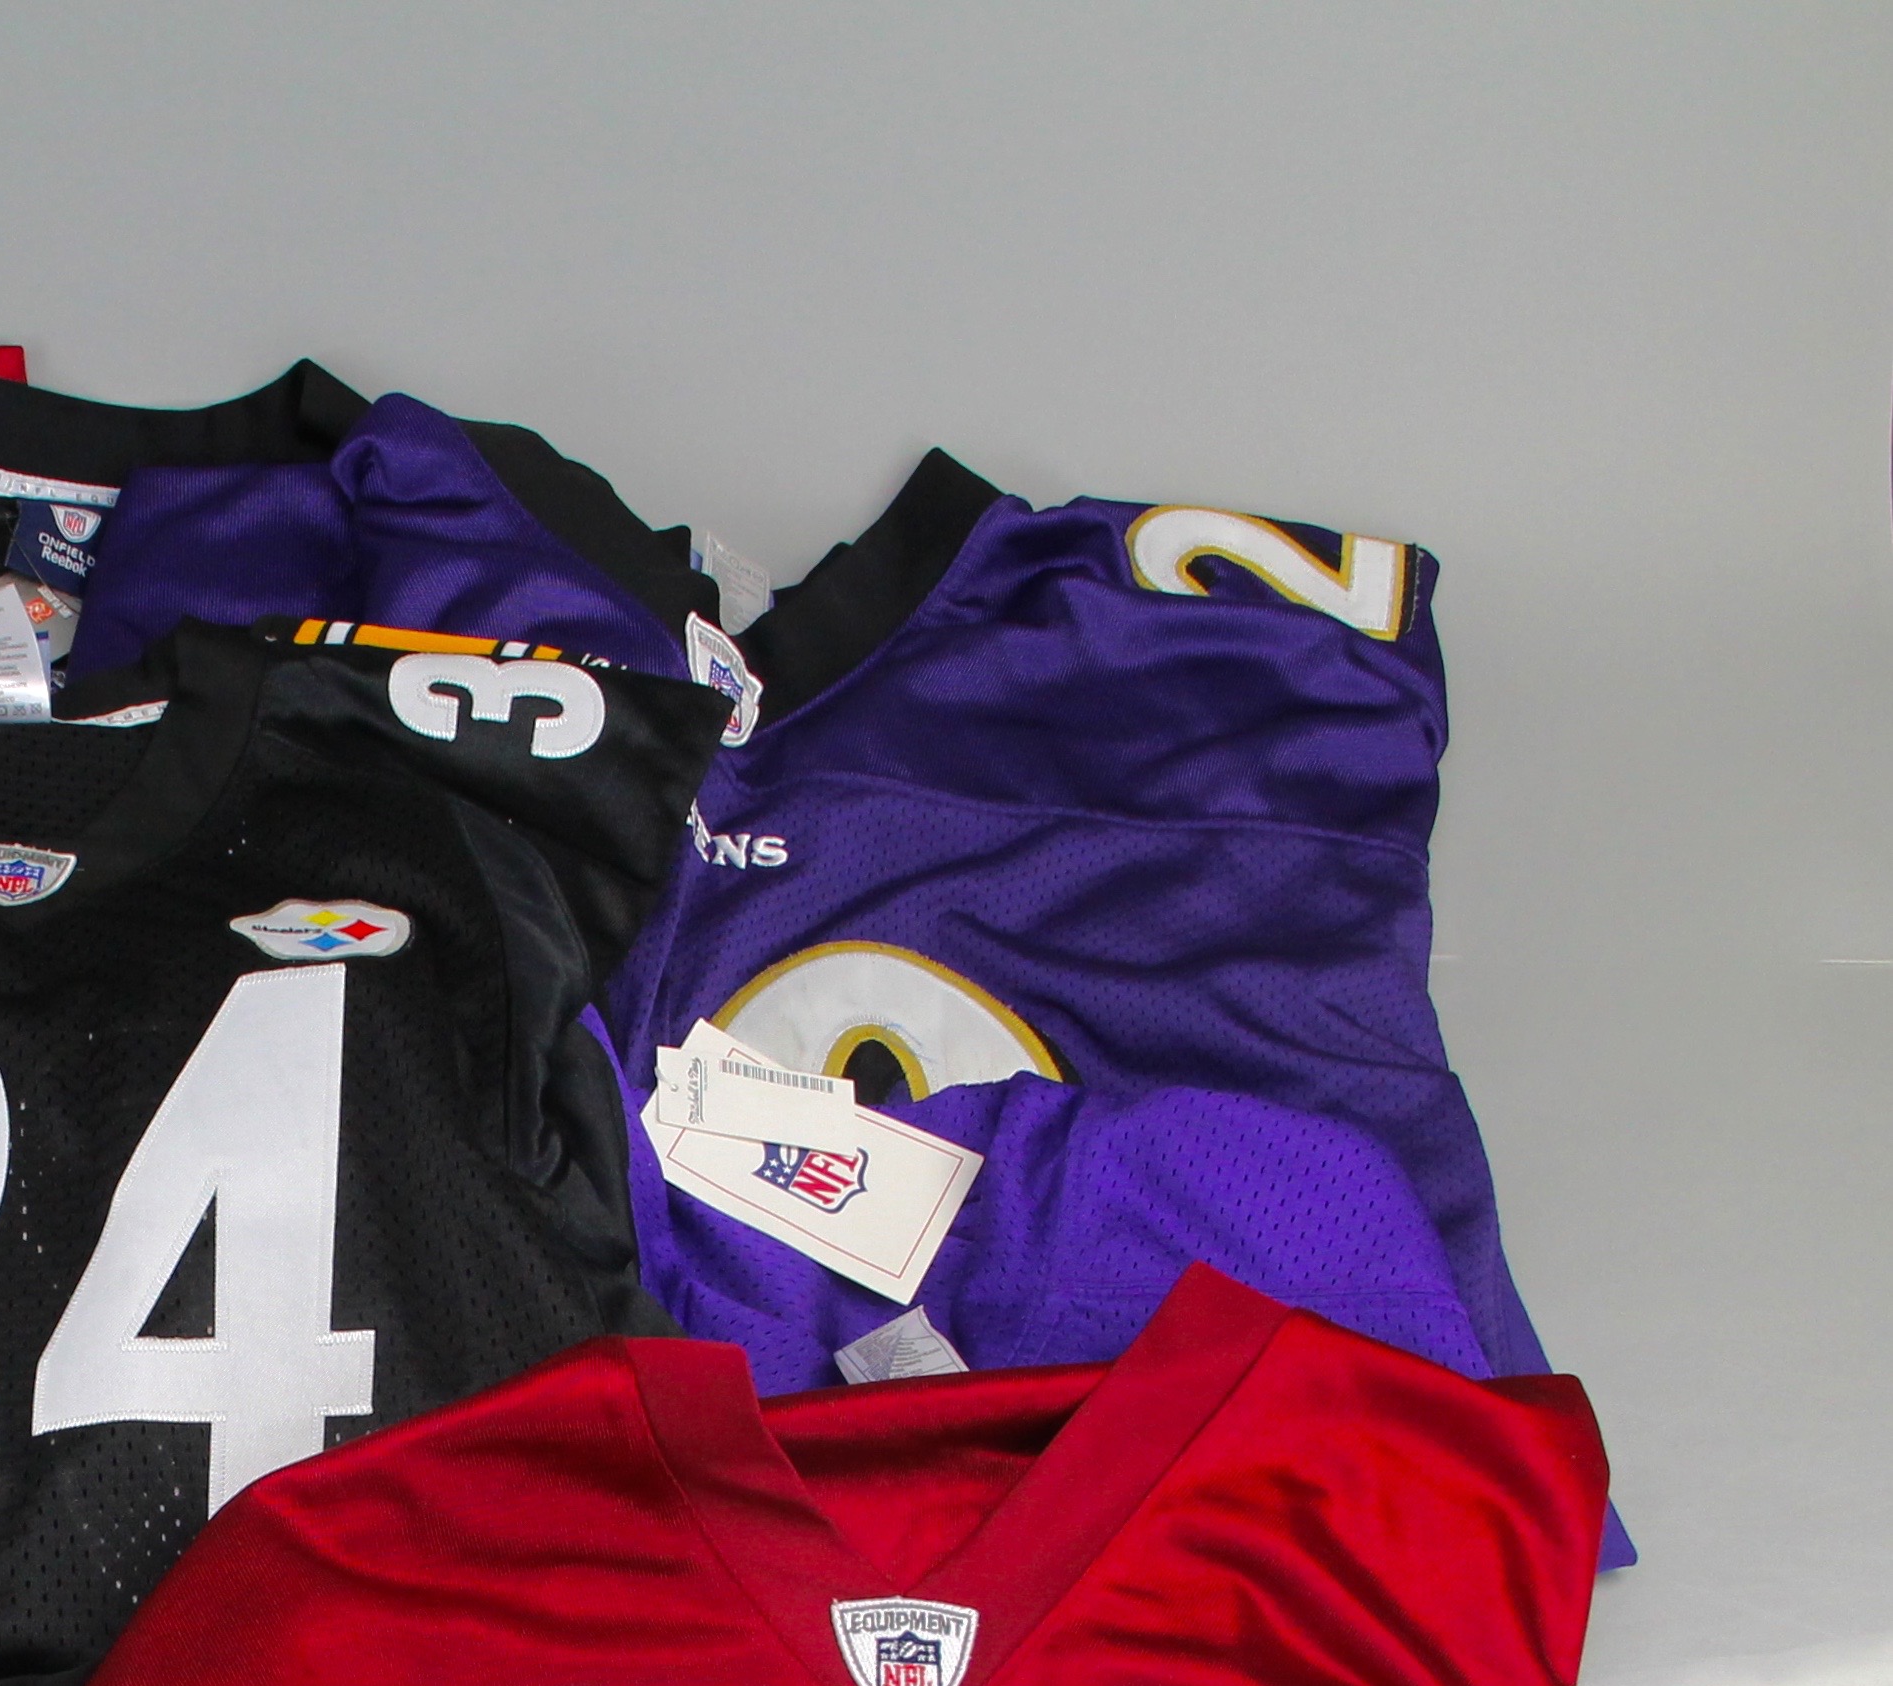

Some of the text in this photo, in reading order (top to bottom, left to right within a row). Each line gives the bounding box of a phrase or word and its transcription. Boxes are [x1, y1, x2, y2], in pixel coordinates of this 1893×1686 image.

[37, 531, 96, 567] ONFIELD
[40, 545, 88, 577] Reebok
[1124, 504, 1406, 641] 2
[388, 652, 606, 758] 3
[790, 1151, 860, 1207] NFL
[847, 1610, 964, 1638] EQUIPMENT
